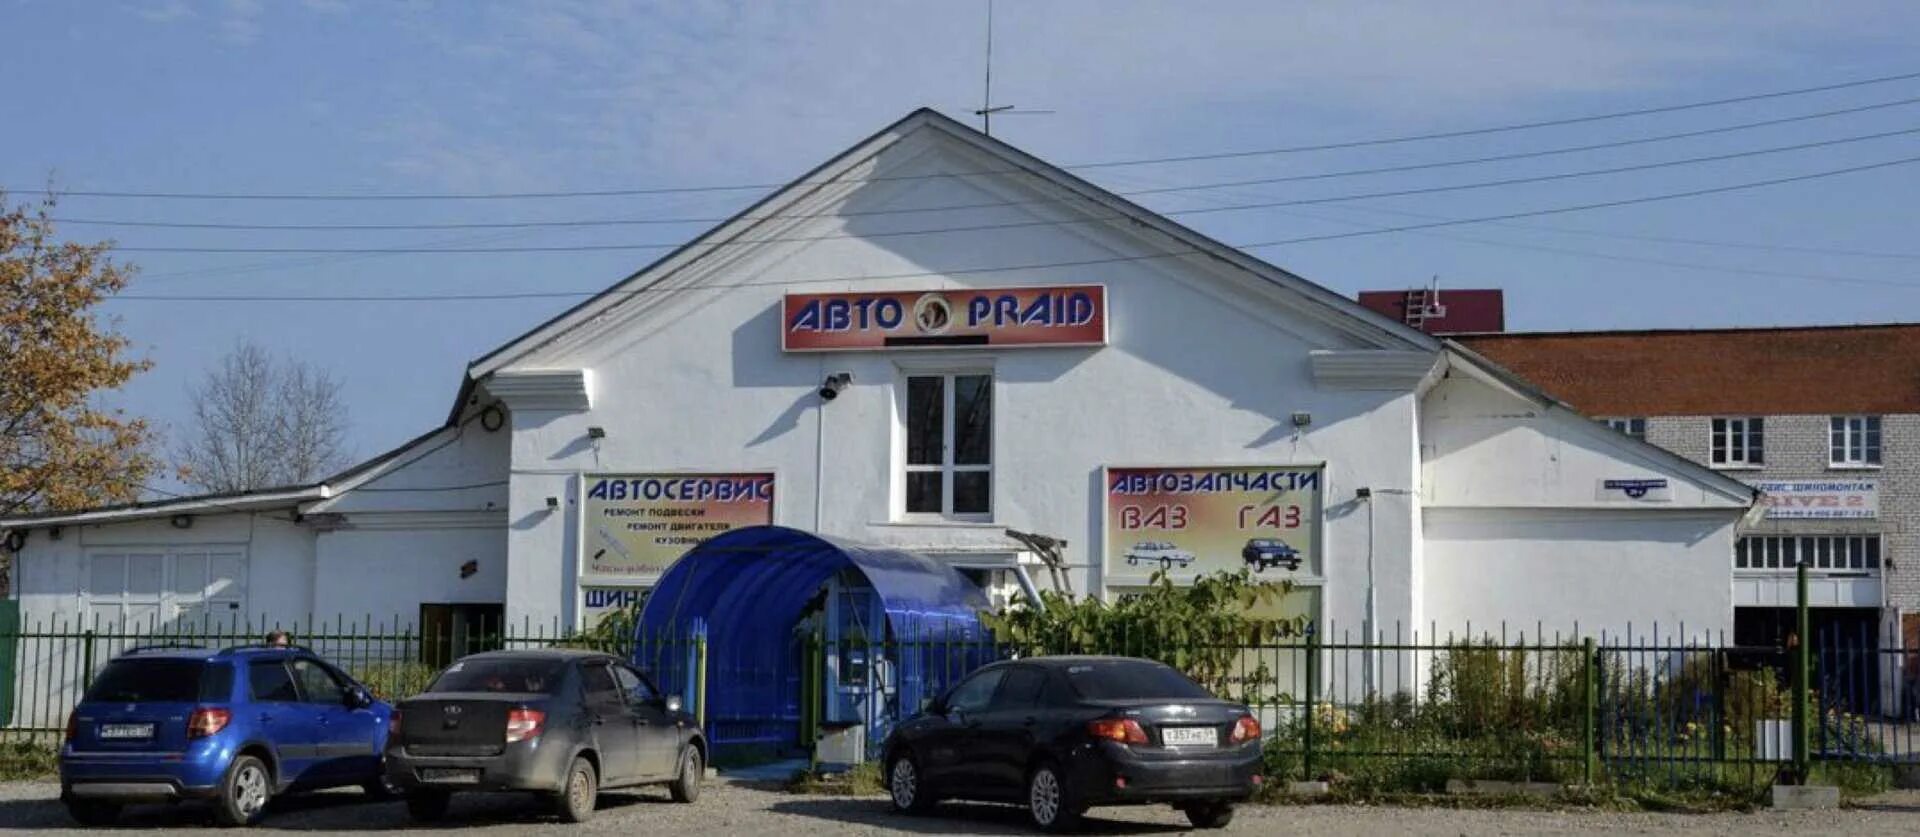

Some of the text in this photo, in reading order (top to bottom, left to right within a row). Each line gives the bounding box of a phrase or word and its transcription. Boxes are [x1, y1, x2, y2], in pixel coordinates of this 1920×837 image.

[790, 289, 1096, 333] АВТО PRAID
[587, 478, 774, 502] АВТОСЕРВИС
[1109, 471, 1319, 494] АВТОЗАПЧАСТИ
[603, 508, 705, 518] РЕМОНТ ПОДВЕСКИ
[1118, 504, 1303, 531] ВАЗ ГАЗ
[627, 522, 731, 532] РЕМОНТ ДВИГАТЕЛЯ
